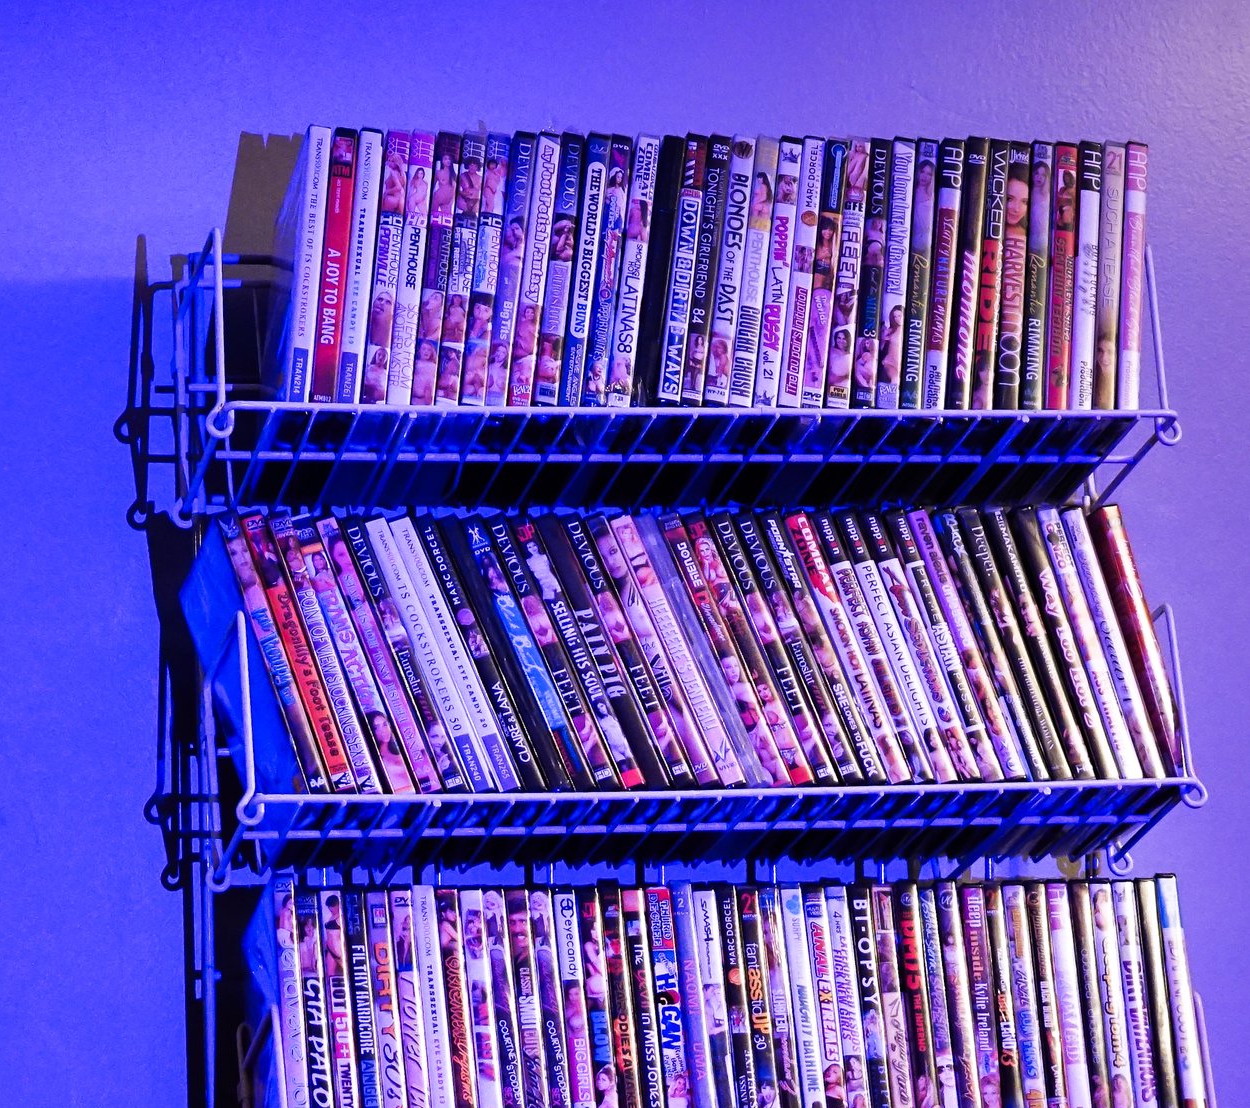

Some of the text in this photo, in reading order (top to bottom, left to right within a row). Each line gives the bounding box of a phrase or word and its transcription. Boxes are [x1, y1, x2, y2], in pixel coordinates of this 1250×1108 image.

[990, 150, 1006, 239] WICKED
[574, 168, 602, 334] THE WORLD'S BIGGEST BUNS
[692, 168, 719, 323] TONIGHT'S GIRLFRIEND 84
[716, 173, 748, 325] BLONDES OF THE PAST
[321, 248, 340, 344] A JOY TO BANG
[293, 358, 304, 394] TRAN214
[343, 362, 353, 398] TRAN261
[906, 319, 922, 382] RIMMING
[797, 516, 833, 593] COMBAT
[971, 526, 995, 577] Deeper.
[491, 524, 585, 714] DEVIOUS FEET
[551, 601, 604, 702] SELLING HIS SOUL
[575, 609, 626, 699] PAIN PIG
[306, 680, 340, 756] Foot Tease
[491, 743, 509, 780] TRAN265
[855, 743, 878, 777] FUCK
[351, 945, 368, 988] FILTHY
[564, 919, 578, 977] eyecandy
[853, 899, 878, 1004] BI-OPSY
[966, 896, 992, 1051] deep inside Kylie Ireland
[304, 979, 322, 1024] GIA
[331, 978, 346, 1008] HOT
[356, 991, 373, 1055] HARDCORE
[546, 1020, 571, 1105] COURTNEY STODDEN
[591, 1010, 608, 1062] BLOW
